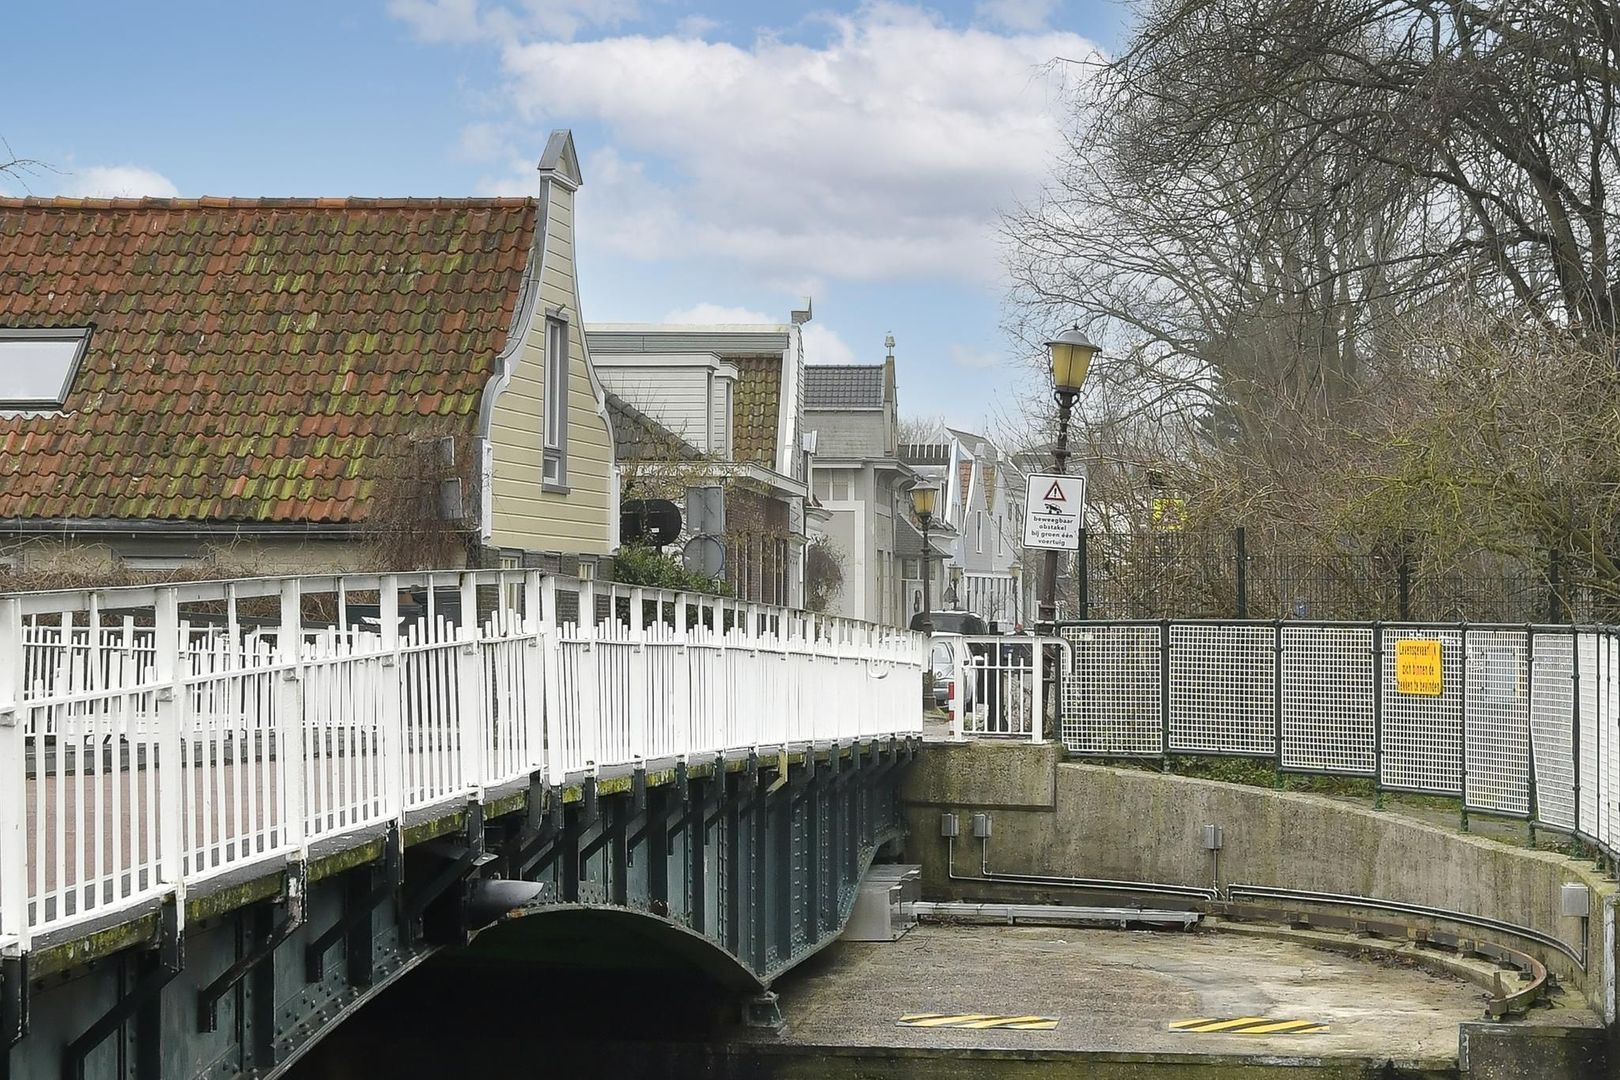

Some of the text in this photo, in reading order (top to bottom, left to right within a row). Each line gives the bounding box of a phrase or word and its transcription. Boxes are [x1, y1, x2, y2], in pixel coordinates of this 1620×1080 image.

[1033, 516, 1073, 524] beweegbaar
[1039, 523, 1067, 531] obstakel
[1031, 530, 1039, 538] bij
